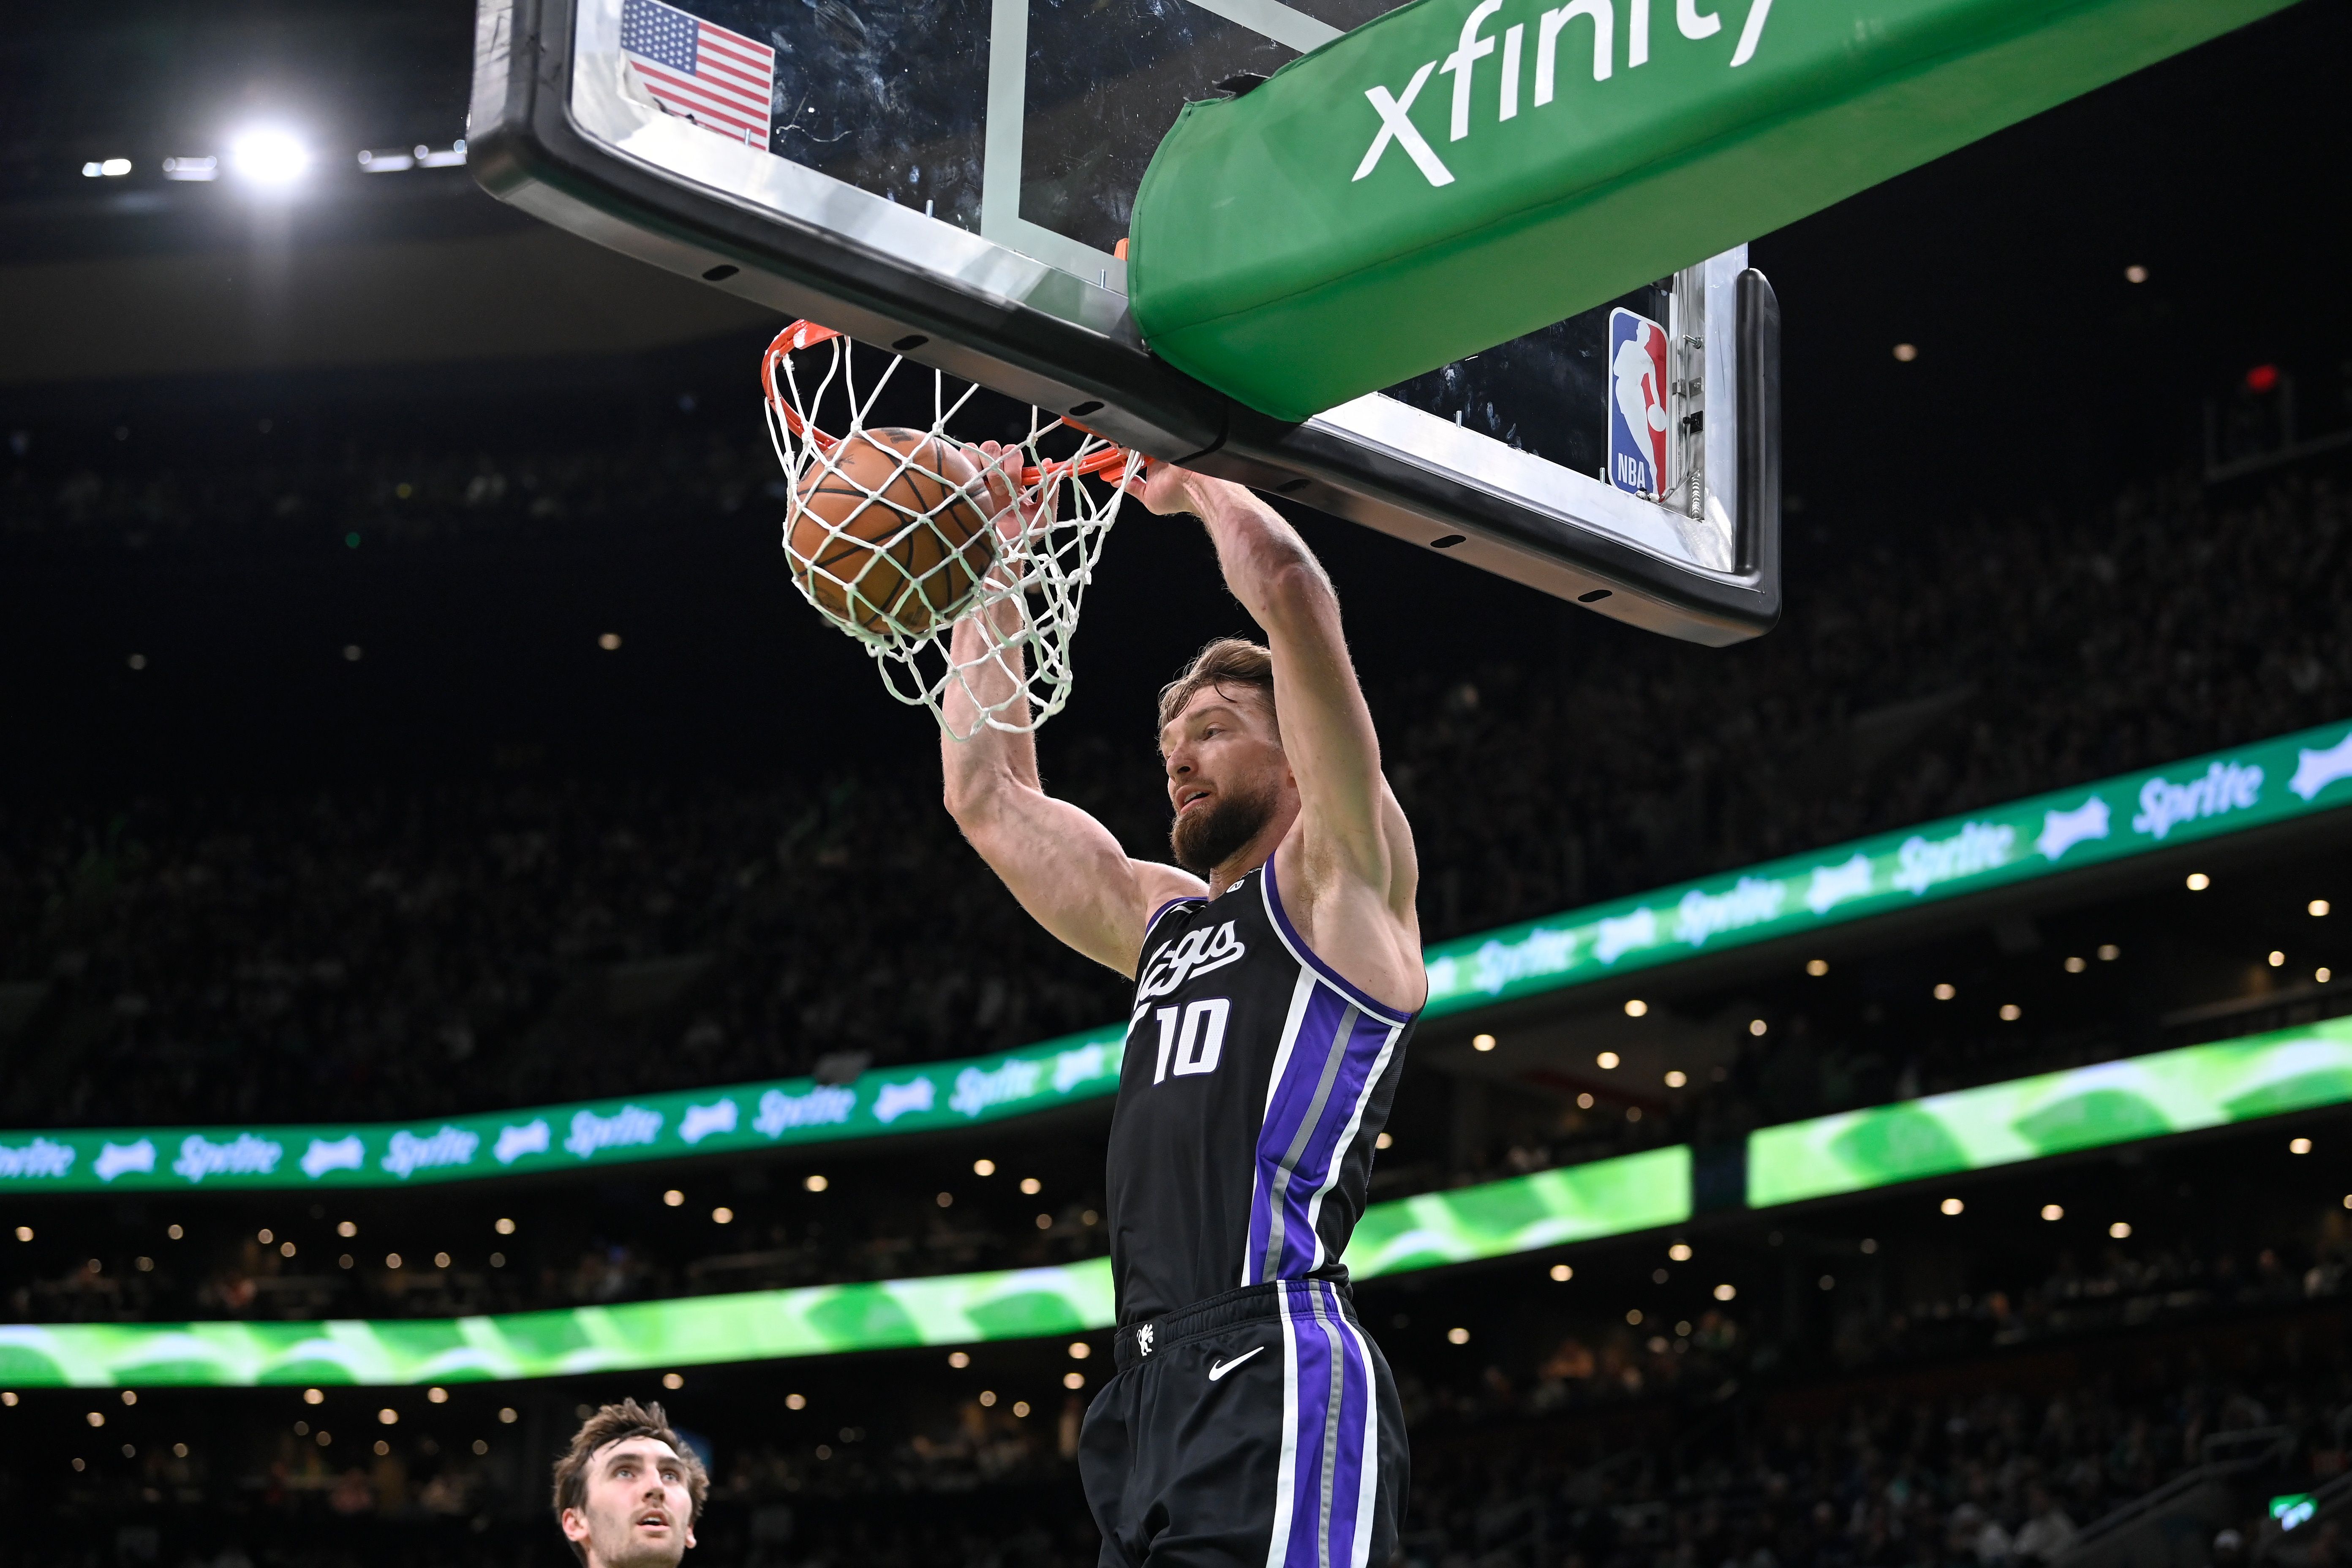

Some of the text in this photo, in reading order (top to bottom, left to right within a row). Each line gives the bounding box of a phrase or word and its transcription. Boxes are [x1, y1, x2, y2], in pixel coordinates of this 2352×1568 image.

[1618, 452, 1645, 489] NBA
[1893, 821, 2015, 896] Sprite
[2132, 761, 2264, 840] Sprite
[1152, 997, 1231, 1086] 10
[173, 1134, 282, 1183] Sprite
[381, 1124, 479, 1179] Sprite
[564, 1104, 663, 1159] Sprite
